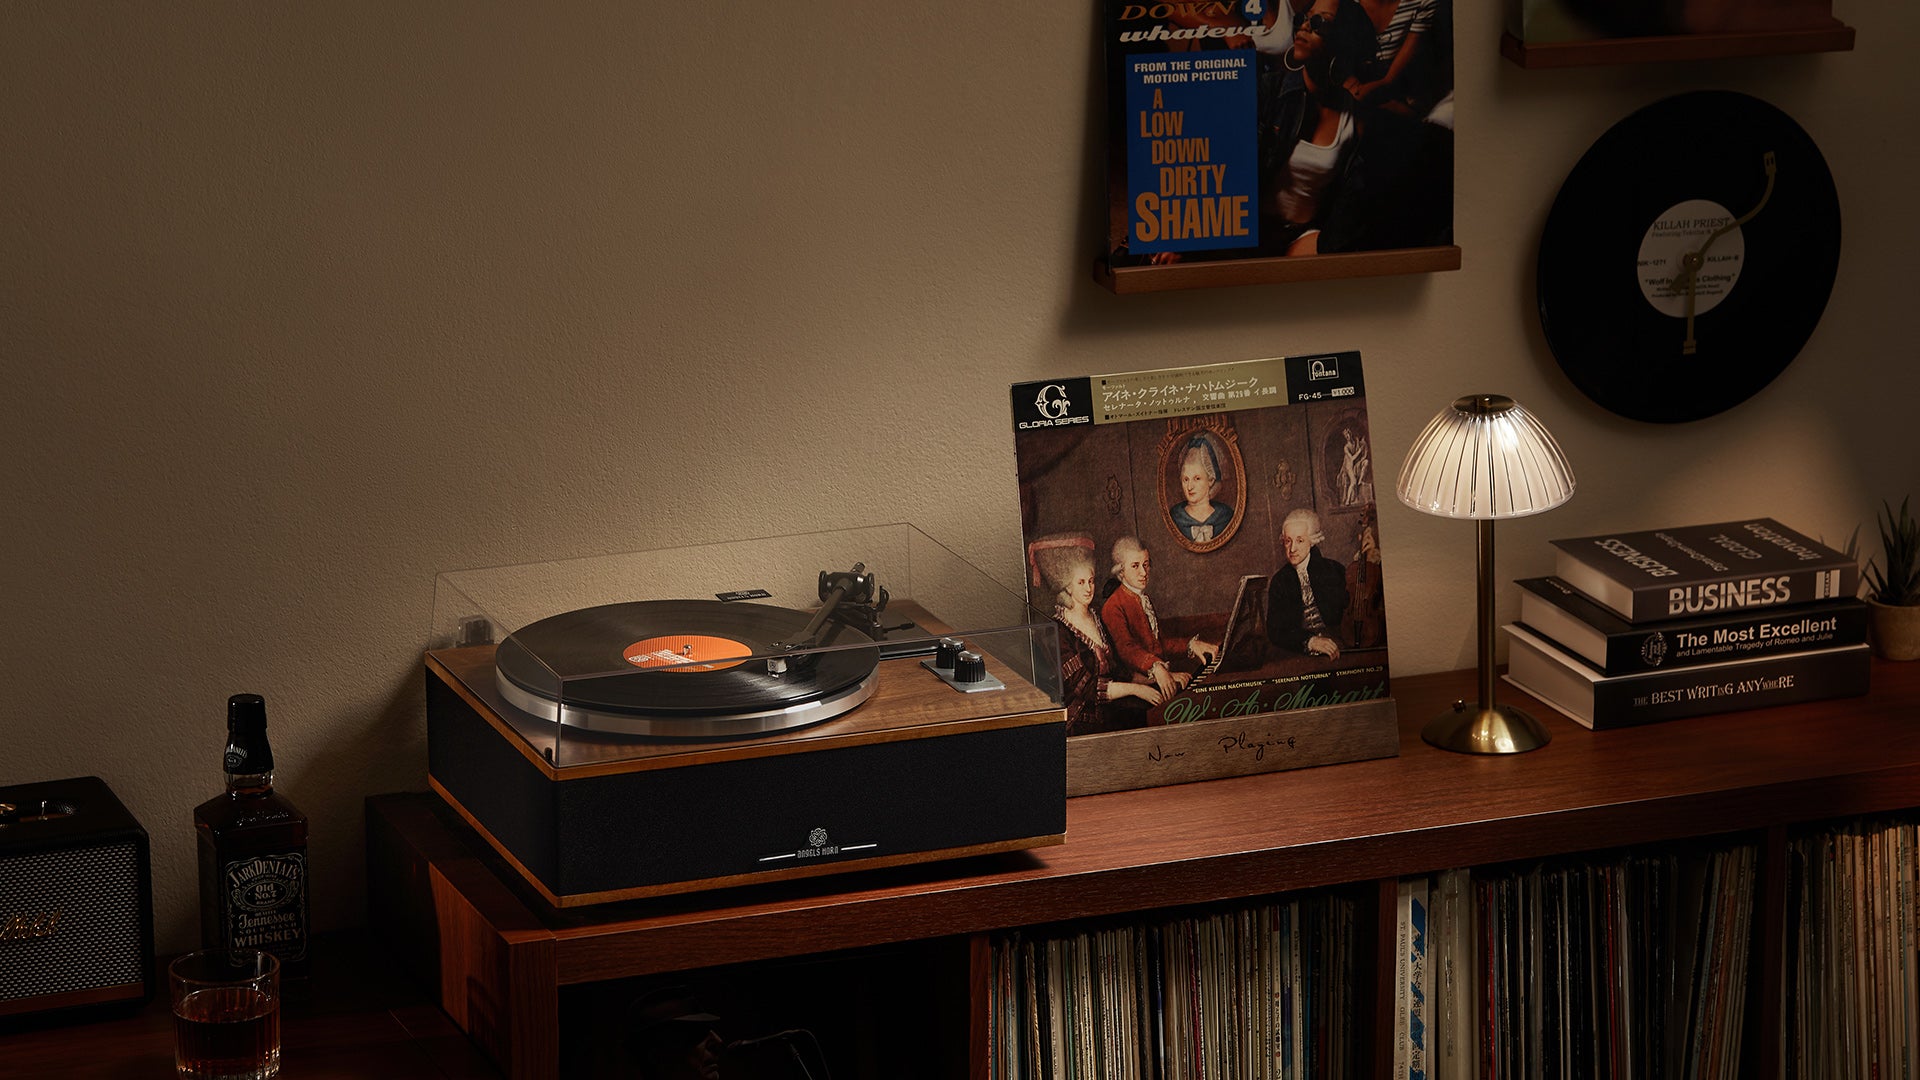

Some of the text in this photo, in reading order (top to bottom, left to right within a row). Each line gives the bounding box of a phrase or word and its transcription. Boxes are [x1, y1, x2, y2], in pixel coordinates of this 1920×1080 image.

[1117, 0, 1262, 20] DOWN 4
[1134, 58, 1247, 73] FROM THE ORIGINAL
[1143, 71, 1239, 84] MOTION PICTURE
[1152, 88, 1164, 110] A
[1140, 110, 1184, 138] LOW
[1151, 137, 1210, 165] DOWN
[1160, 164, 1226, 197] DIRTY
[1135, 191, 1249, 242] SHAME
[1653, 217, 1730, 230] KILLAH PRIEST
[1018, 415, 1090, 429] GLORIA SERIES
[1594, 538, 1679, 577] BUSINESS
[1668, 576, 1791, 615] BUSINESS
[1676, 633, 1708, 649] The
[1713, 626, 1755, 645] Most
[1760, 616, 1838, 639] Excellent
[1676, 648, 1690, 658] and
[1691, 643, 1734, 657] Lamentable
[1735, 640, 1764, 653] Tragedy
[1765, 639, 1774, 648] of
[1774, 636, 1800, 646] Romeo
[1801, 634, 1813, 643] and
[1208, 685, 1227, 693] KLEINE
[1633, 697, 1649, 707] THE
[1651, 690, 1684, 705] BEST
[1736, 675, 1795, 695] ANYWHERE
[1149, 731, 1296, 762] Now Playing
[255, 882, 275, 892] Old
[238, 912, 296, 929] Tennessee
[233, 928, 302, 948] WHISKEY
